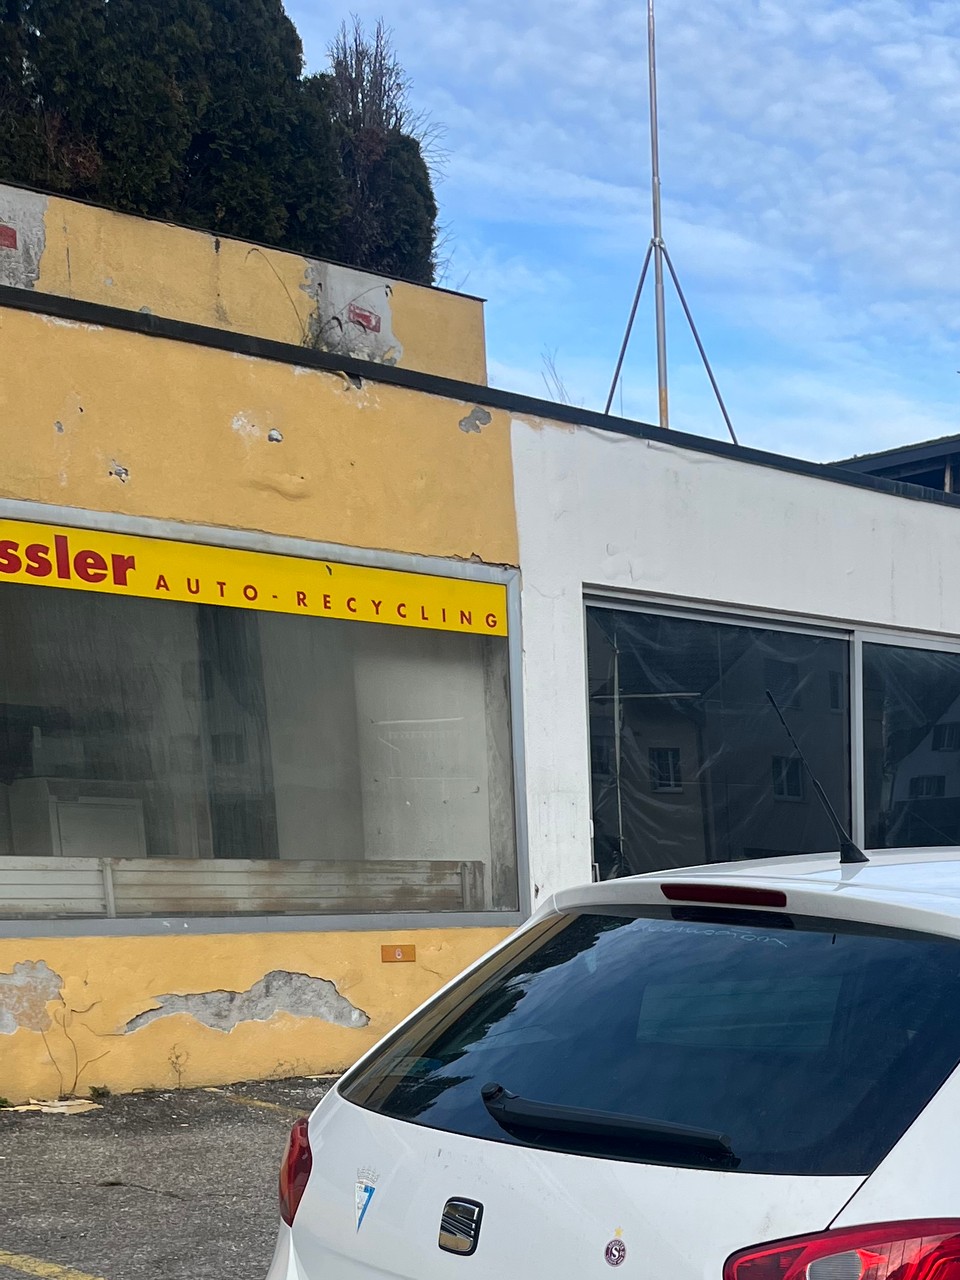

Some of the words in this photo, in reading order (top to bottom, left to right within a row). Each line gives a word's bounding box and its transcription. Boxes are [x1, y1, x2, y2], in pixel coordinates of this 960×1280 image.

[0, 534, 136, 587] ssler
[155, 574, 497, 629] AUTO-RECYCLING
[395, 948, 403, 959] 6
